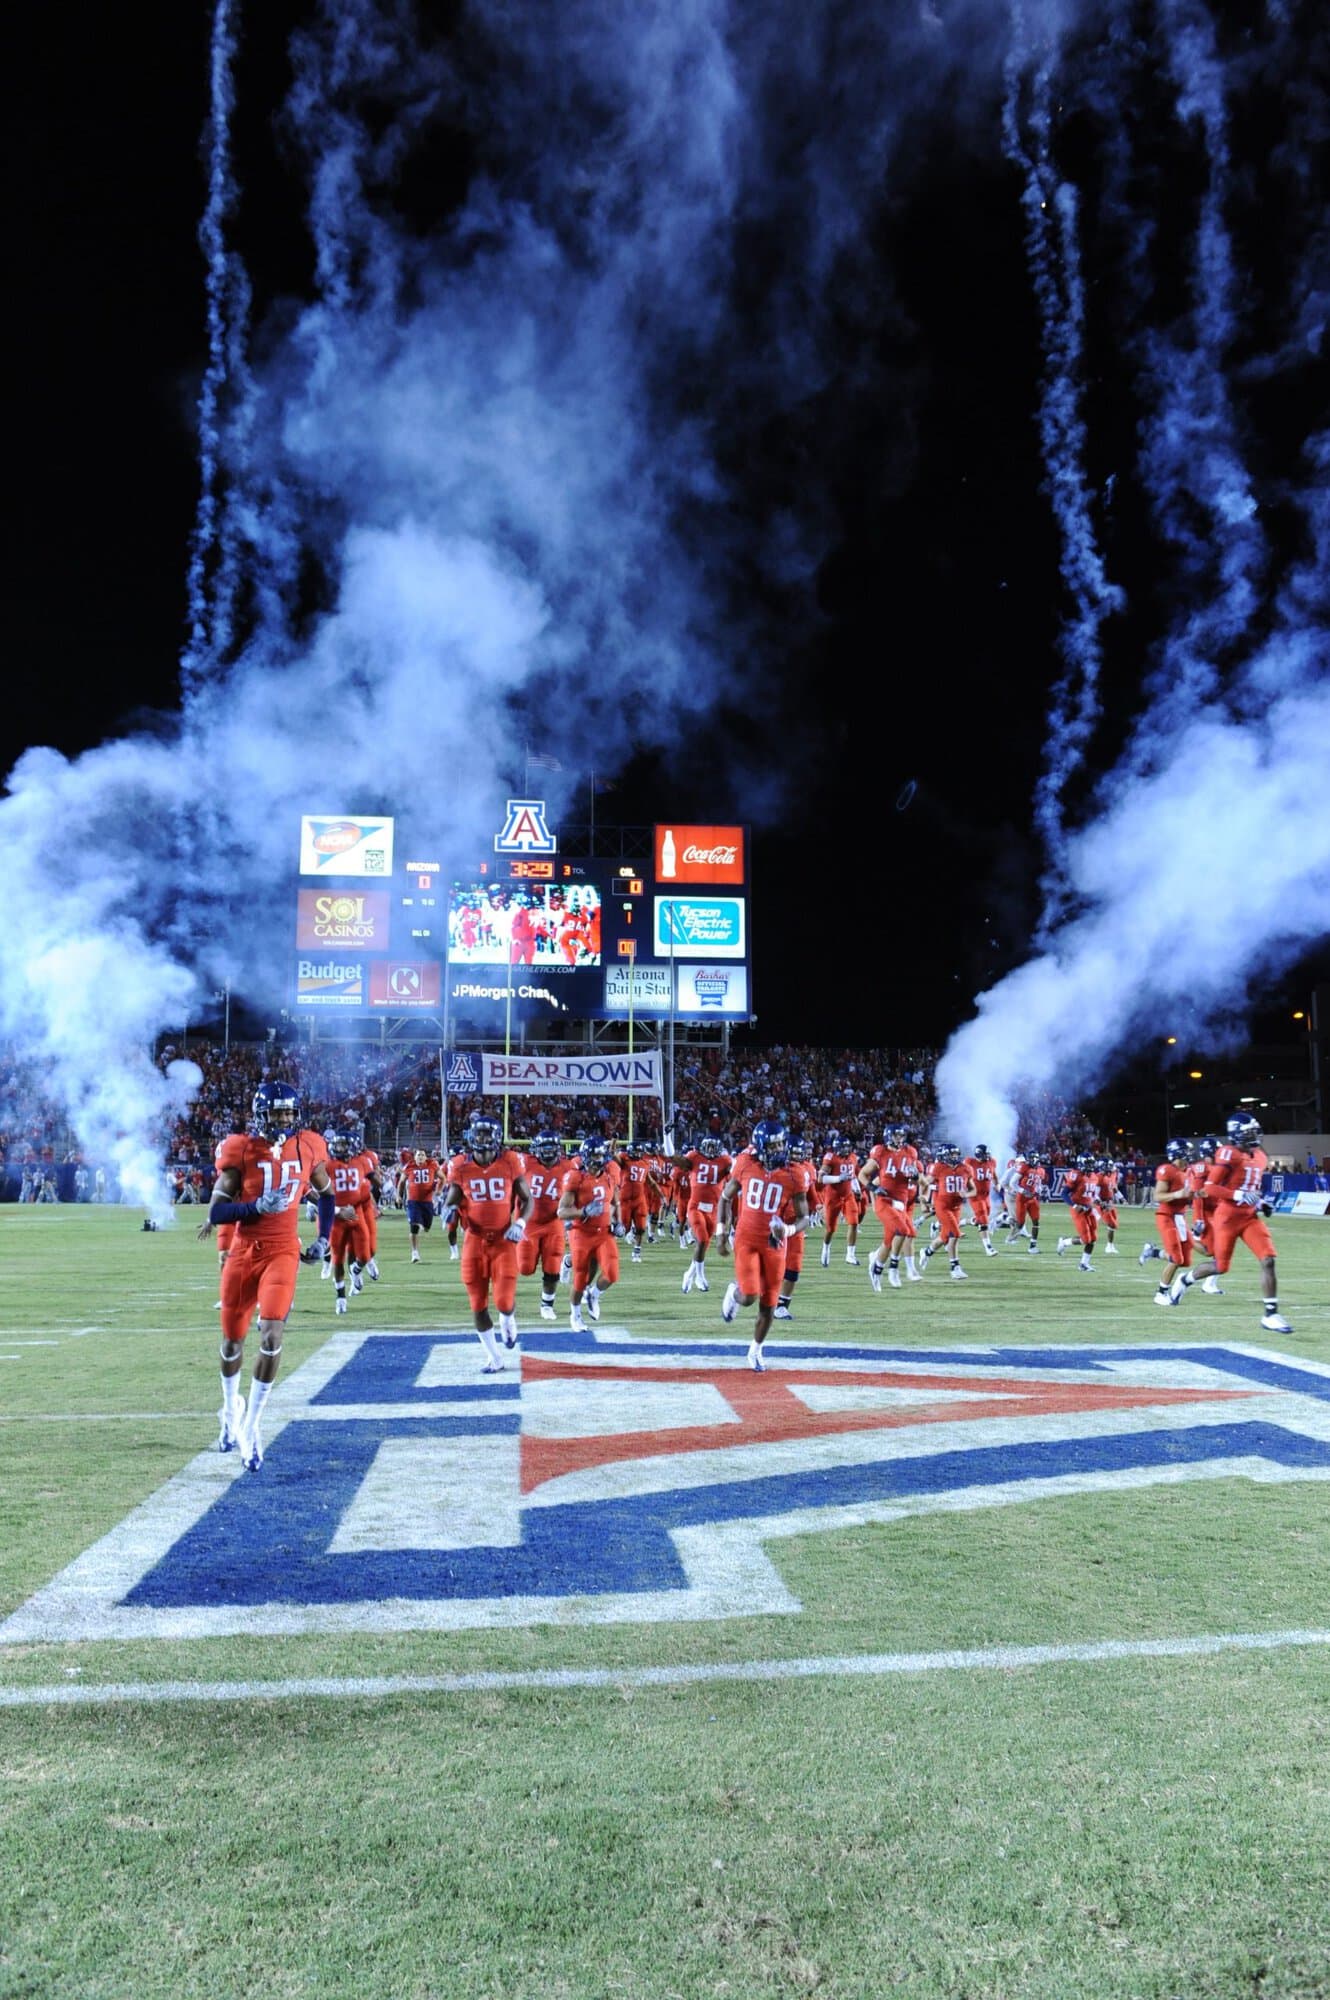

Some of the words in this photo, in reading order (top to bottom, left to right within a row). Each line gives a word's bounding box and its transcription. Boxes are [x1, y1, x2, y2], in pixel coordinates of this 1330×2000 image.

[494, 800, 557, 853] A
[510, 862, 553, 877] 3:29
[562, 865, 571, 876] 3
[630, 881, 642, 894] 0
[314, 896, 374, 924] SOL
[679, 905, 721, 918] Tucson
[313, 925, 374, 937] CASINOS
[684, 917, 733, 929] Electric
[688, 927, 733, 940] Power
[298, 960, 363, 985] Budget
[614, 967, 665, 981] Arzona
[452, 984, 515, 1000] JPMorgan
[606, 982, 642, 998] Daiy
[447, 1082, 477, 1092] CLUB
[257, 1159, 302, 1203] 16
[334, 1168, 360, 1191] 23
[413, 1169, 430, 1184] 36
[630, 1165, 646, 1182] 57
[697, 1163, 719, 1185] 21
[470, 1178, 505, 1202] 26
[530, 1174, 558, 1200] 54
[945, 1175, 963, 1193] 60
[747, 1178, 783, 1213] 80
